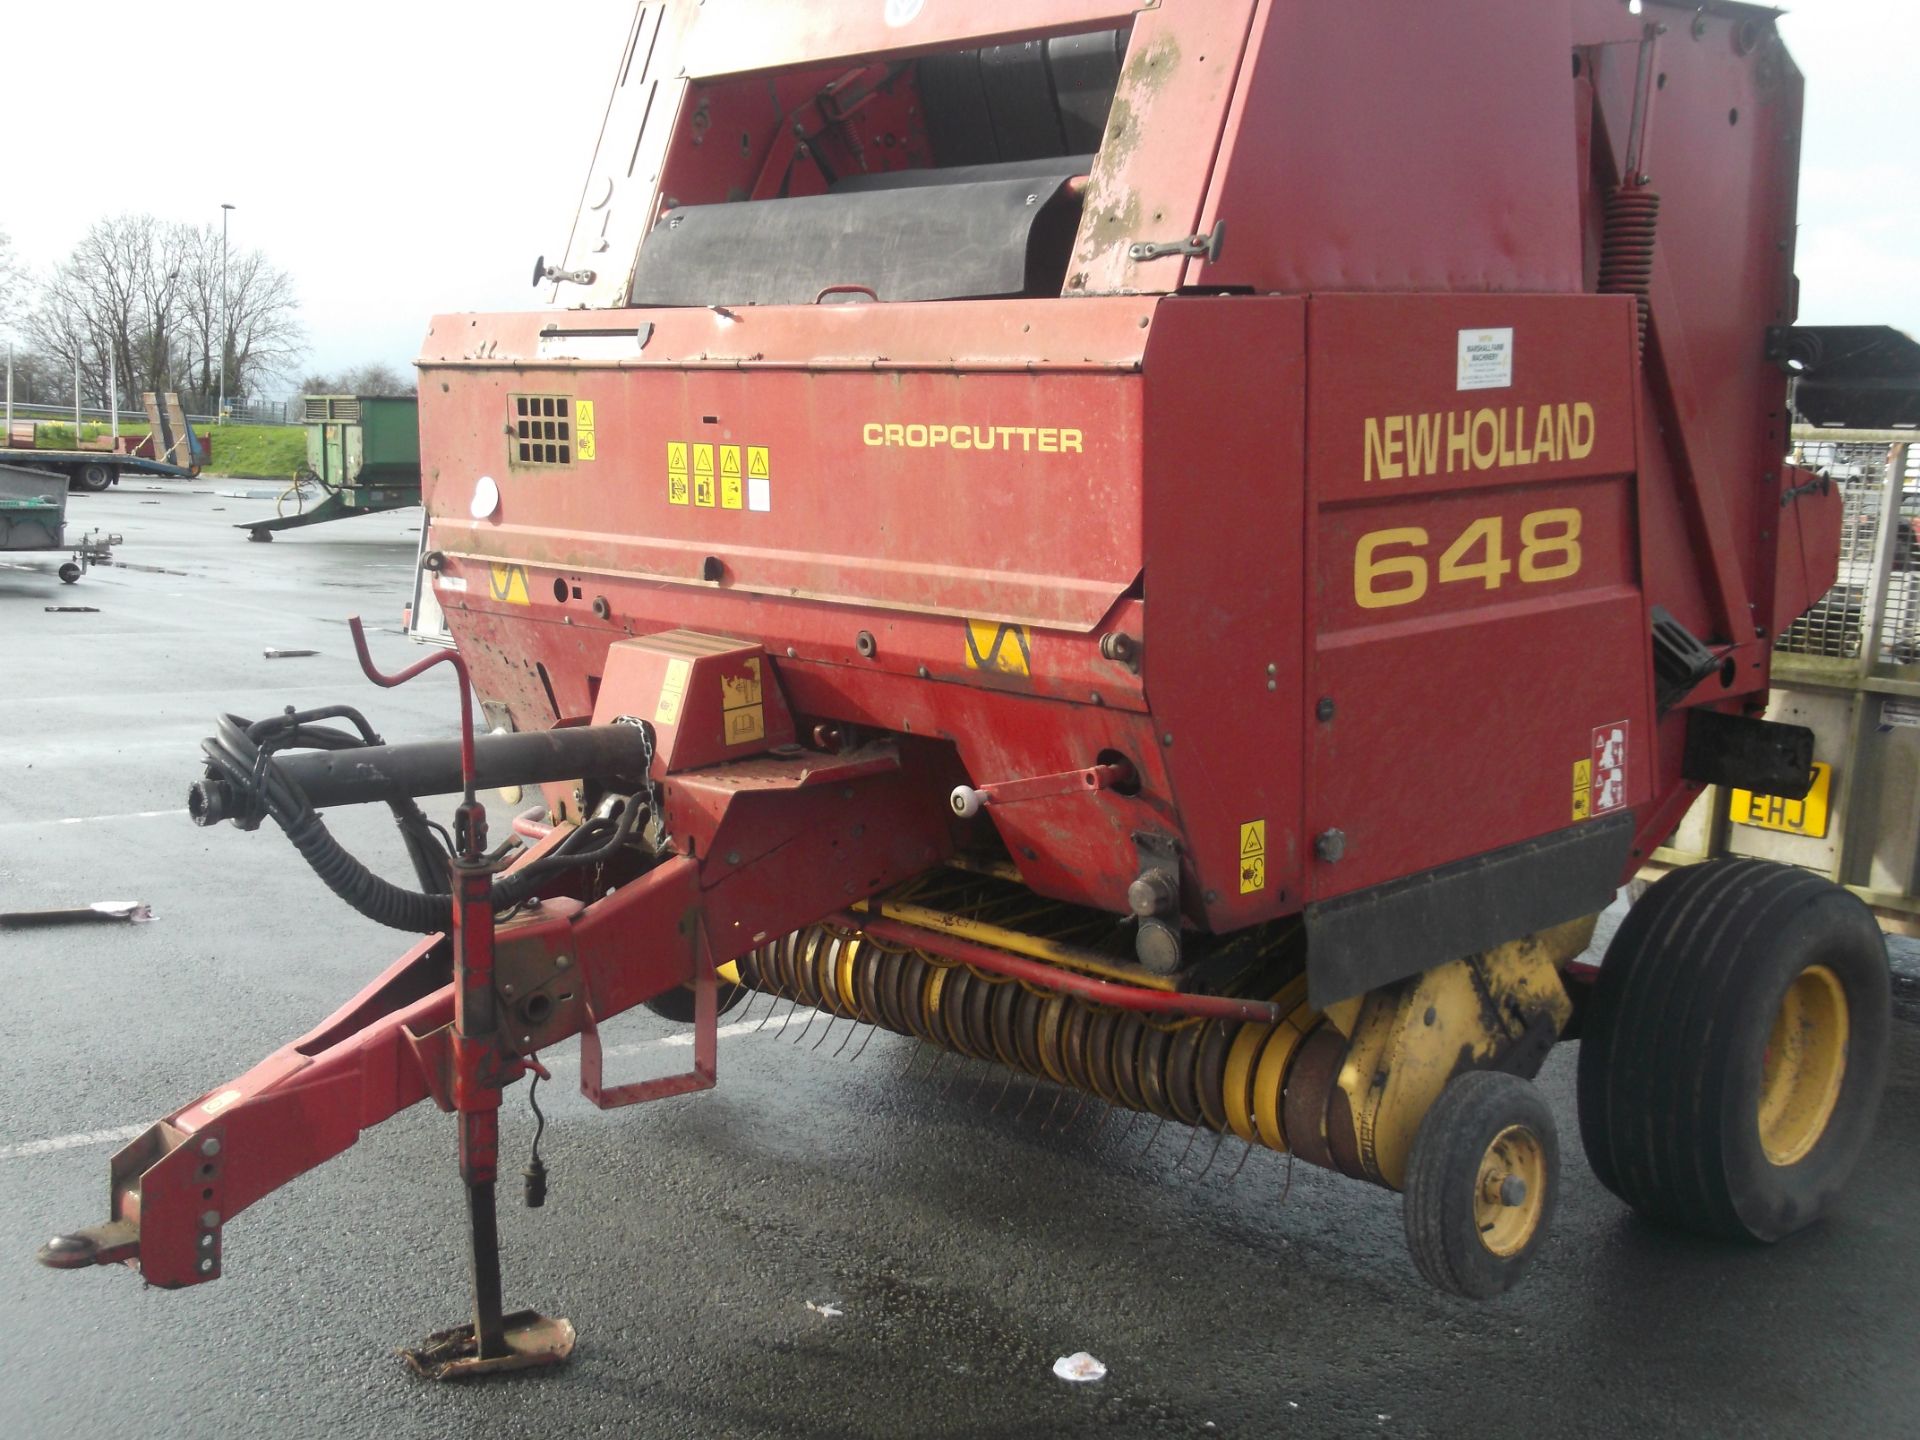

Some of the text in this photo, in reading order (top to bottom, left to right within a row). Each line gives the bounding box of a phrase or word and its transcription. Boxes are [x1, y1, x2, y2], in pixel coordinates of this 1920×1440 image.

[863, 423, 1083, 453] CROPCUTTER
[1363, 402, 1595, 482] NEW HOLLAND
[1354, 507, 1582, 609] 648
[1748, 791, 1806, 828] EHJ
